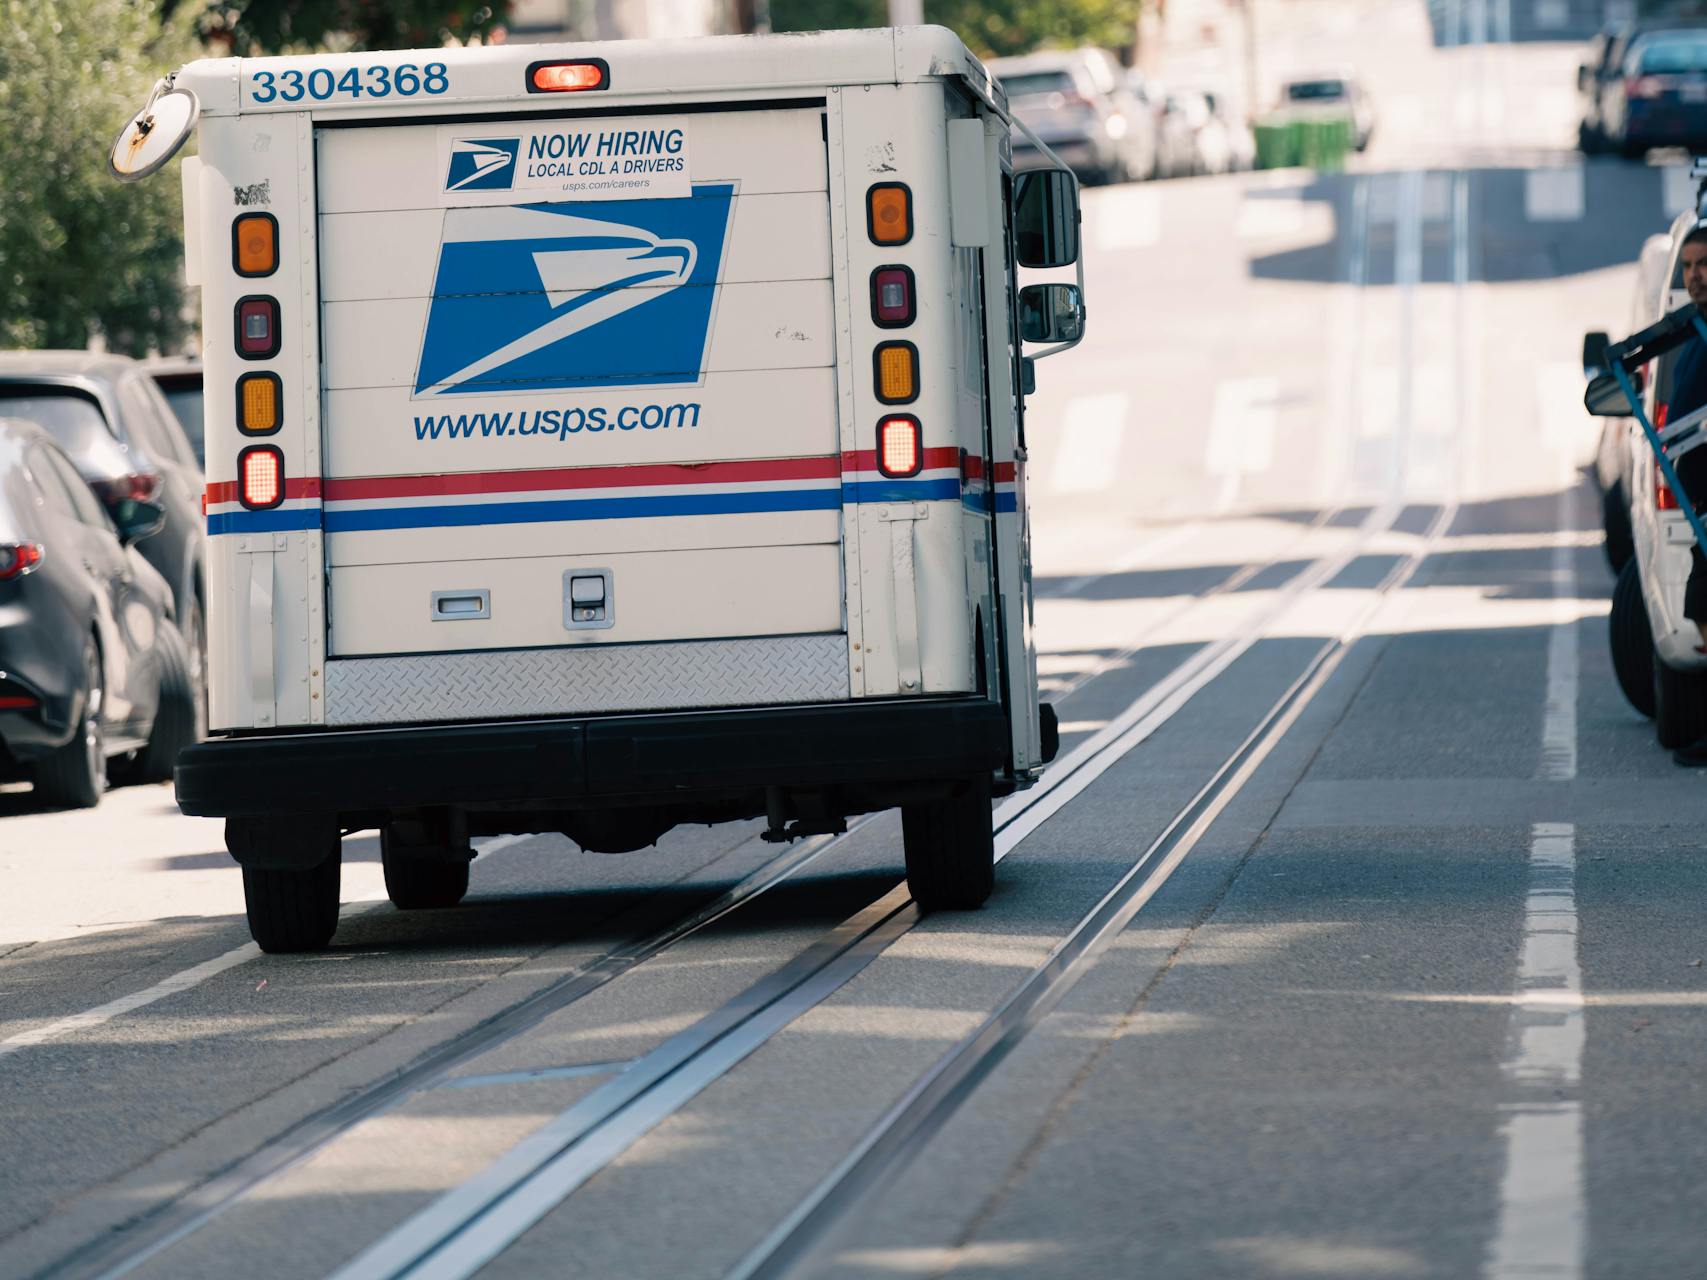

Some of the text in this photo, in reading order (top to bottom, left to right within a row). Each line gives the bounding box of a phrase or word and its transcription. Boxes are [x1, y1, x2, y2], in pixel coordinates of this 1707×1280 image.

[251, 62, 449, 103] 3304368
[528, 129, 684, 159] NOW HIRING
[528, 157, 684, 178] LOCAL CDL A DRIVERS
[562, 179, 650, 192] usps.com/careers
[414, 402, 701, 442] www.usps.com
